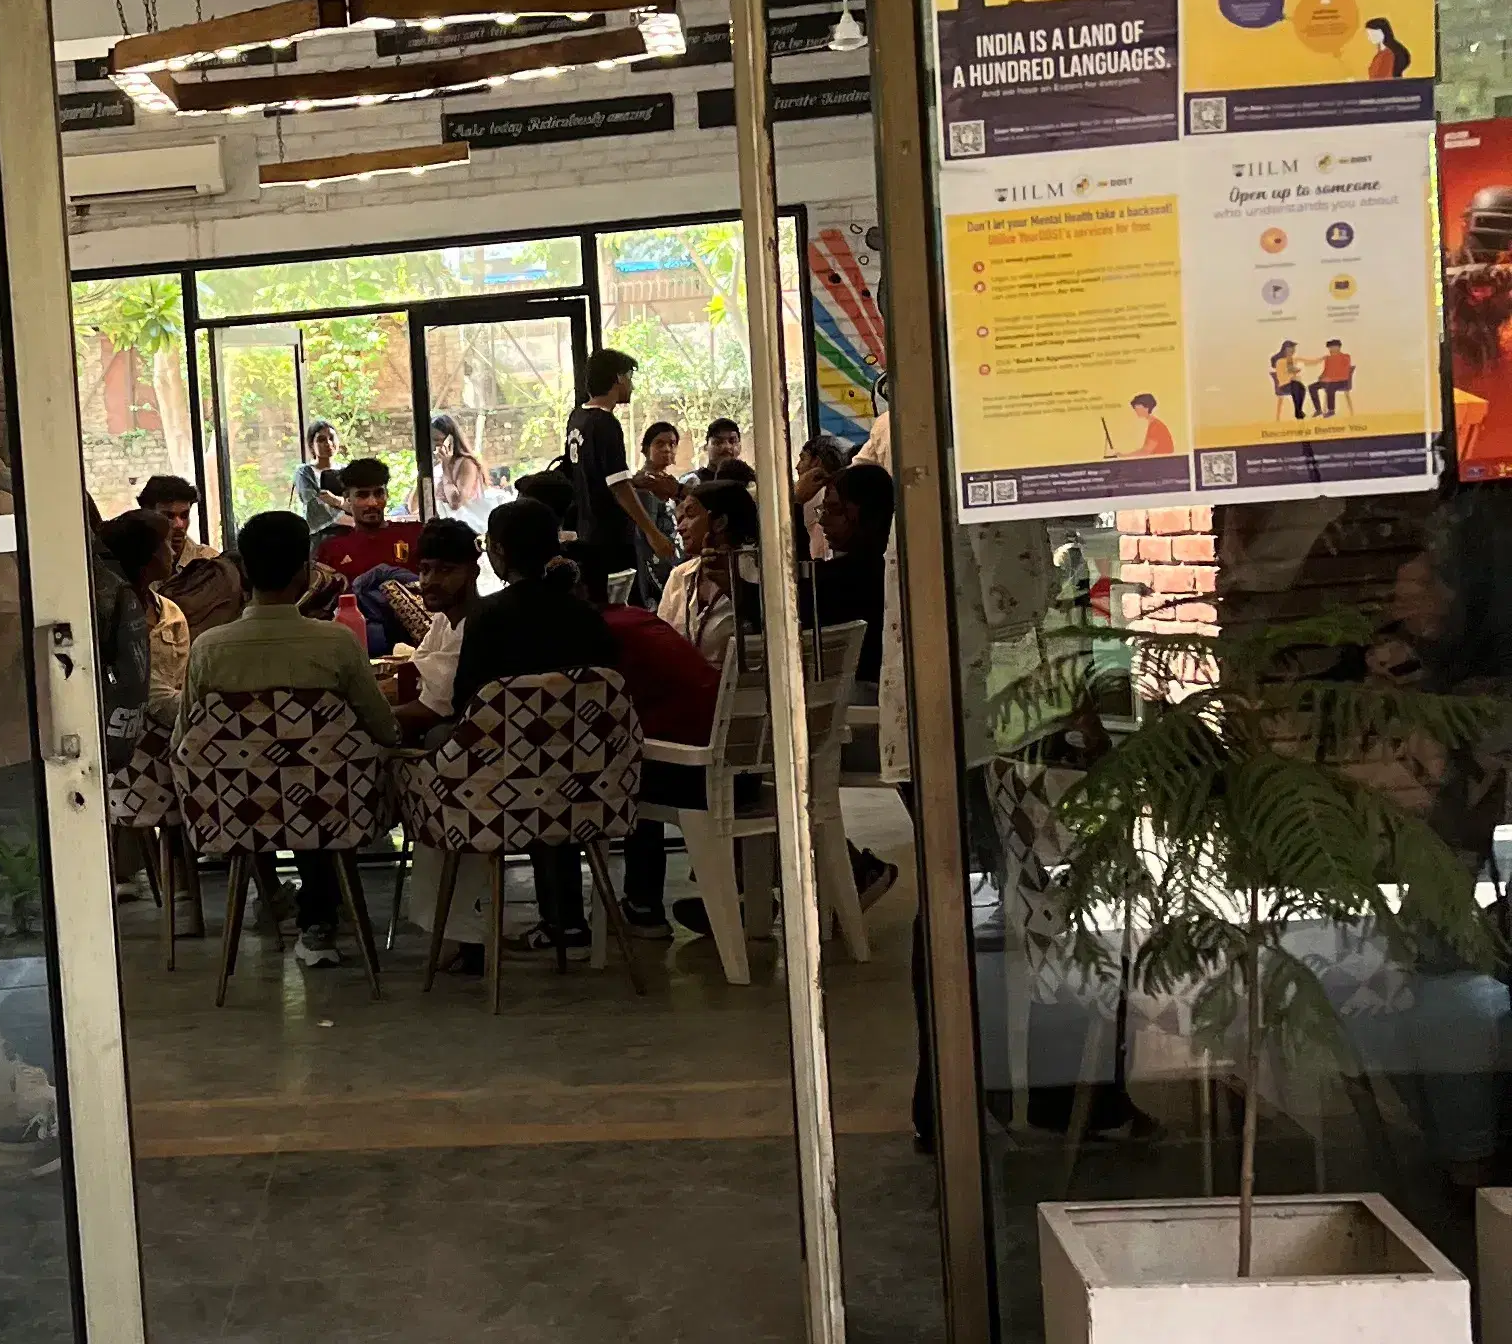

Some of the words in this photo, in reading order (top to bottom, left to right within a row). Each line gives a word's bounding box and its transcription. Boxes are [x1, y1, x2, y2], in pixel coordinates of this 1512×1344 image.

[976, 32, 1026, 58] INDIA
[1030, 28, 1047, 53] IS
[1051, 28, 1064, 50] A
[1068, 23, 1117, 49] LAND
[1121, 20, 1144, 43] OF
[952, 65, 966, 88] A
[969, 57, 1054, 87] HUNDRED
[1059, 47, 1171, 78] LANGUAGES.
[489, 120, 522, 138] today
[1248, 159, 1299, 176] IILM
[1012, 182, 1064, 202] IILM
[1229, 186, 1267, 206] Open
[1271, 189, 1291, 203] up
[1296, 183, 1311, 198] to
[1315, 179, 1381, 194] someone
[1213, 208, 1242, 219] who
[1245, 201, 1330, 217] understands
[1331, 201, 1356, 213] you
[1359, 194, 1400, 207] about
[1007, 218, 1028, 232] your
[1031, 214, 1062, 227] Mental
[1065, 211, 1094, 223] Health
[1095, 209, 1116, 220] take
[1119, 210, 1125, 218] a
